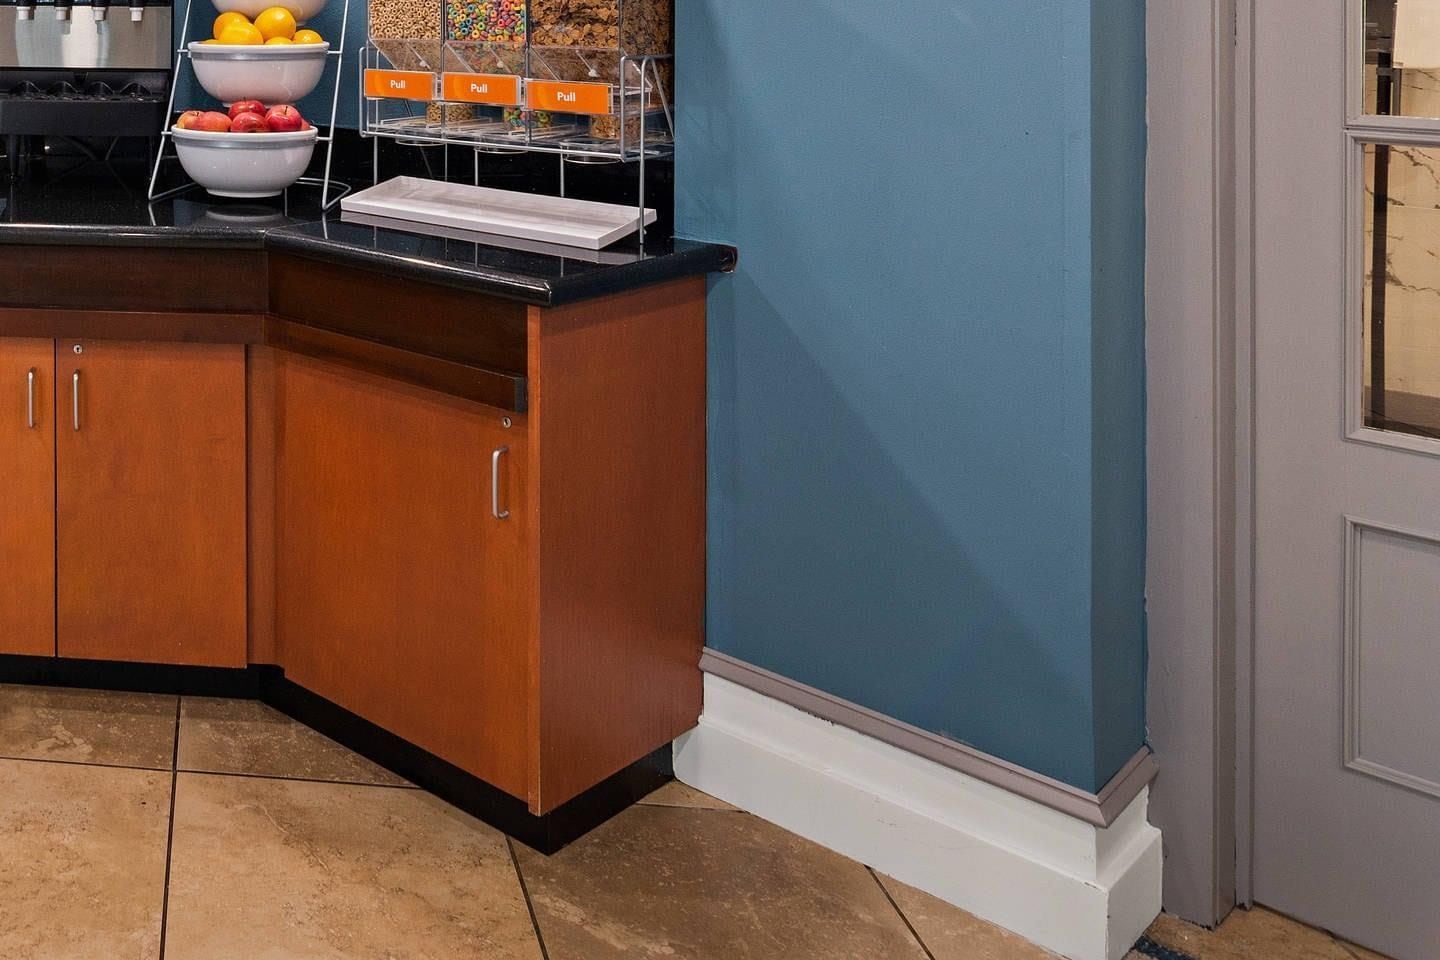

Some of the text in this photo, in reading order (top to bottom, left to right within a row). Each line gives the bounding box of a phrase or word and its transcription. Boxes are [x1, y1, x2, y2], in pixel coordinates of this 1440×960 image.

[390, 79, 406, 89] Pull
[470, 83, 488, 93] Pull
[556, 91, 576, 102] Pull
